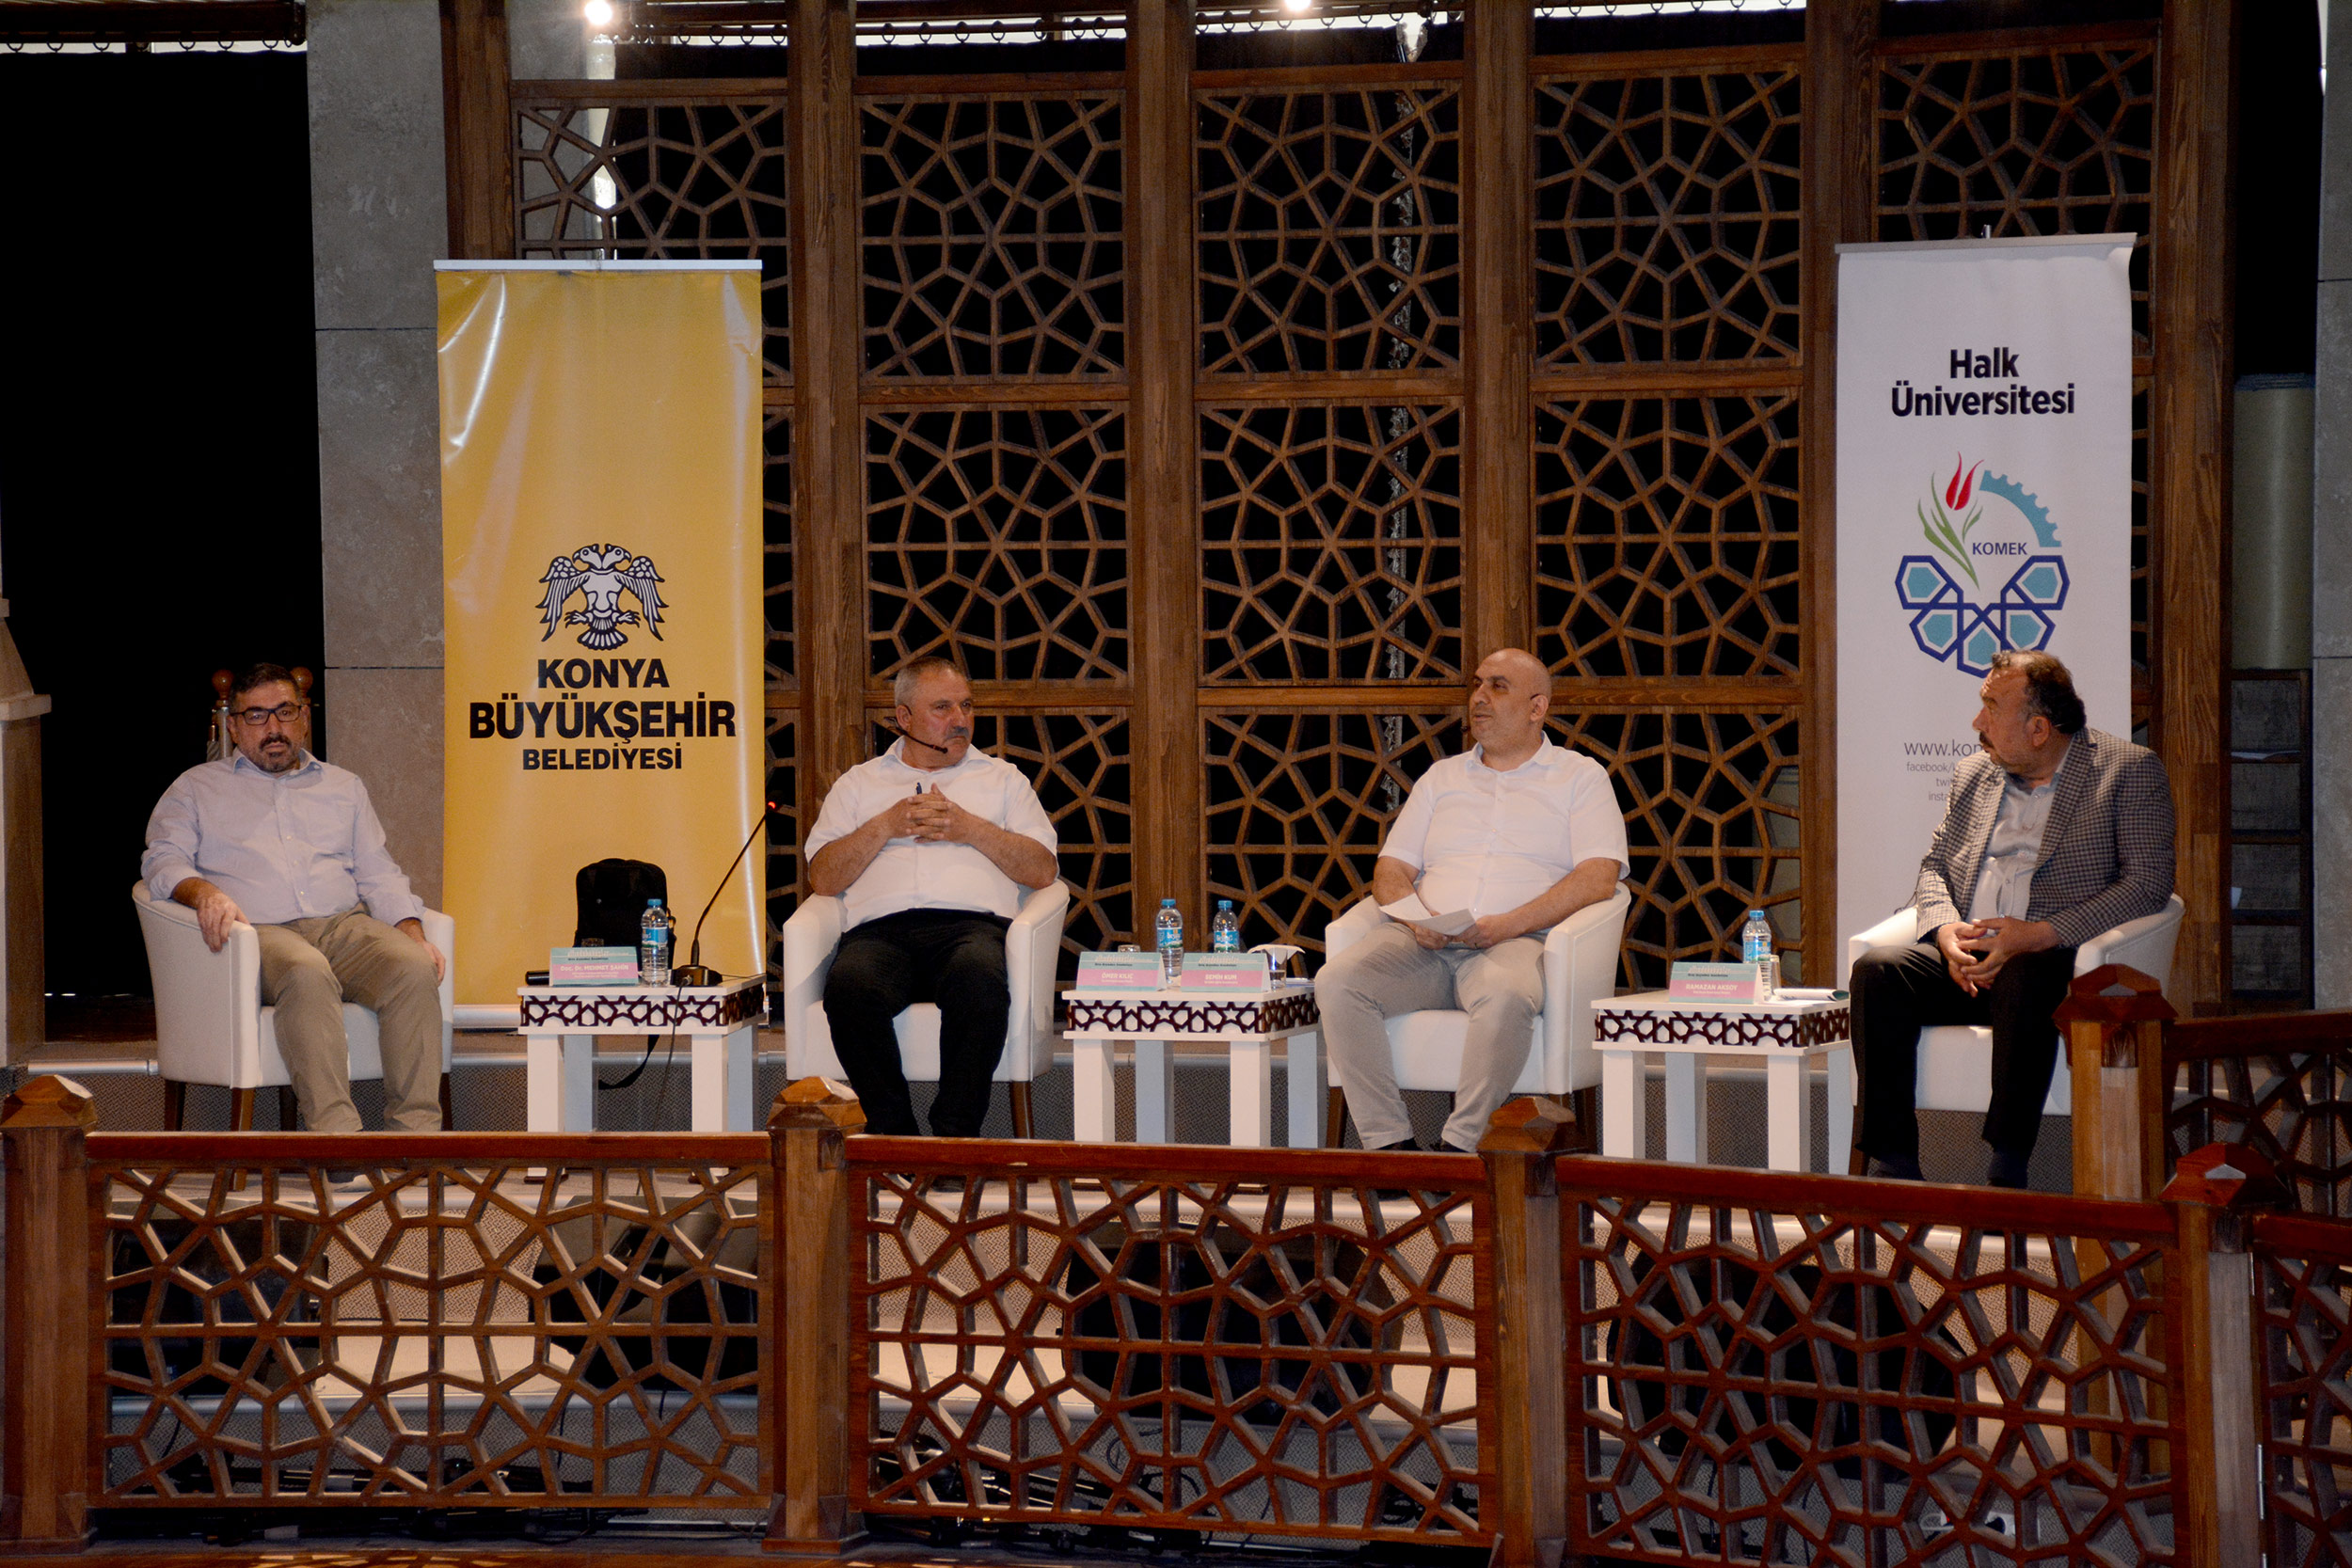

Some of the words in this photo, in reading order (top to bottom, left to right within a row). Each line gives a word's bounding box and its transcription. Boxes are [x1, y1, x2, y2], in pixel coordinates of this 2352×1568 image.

[1949, 346, 2020, 379] Halk
[1891, 380, 2075, 417] Üniversitesi
[1972, 542, 2027, 556] KOMEK
[537, 657, 670, 689] KONYA
[469, 691, 737, 744] BÜYÜKŞEHİR
[522, 742, 682, 770] BELEDİYESİ
